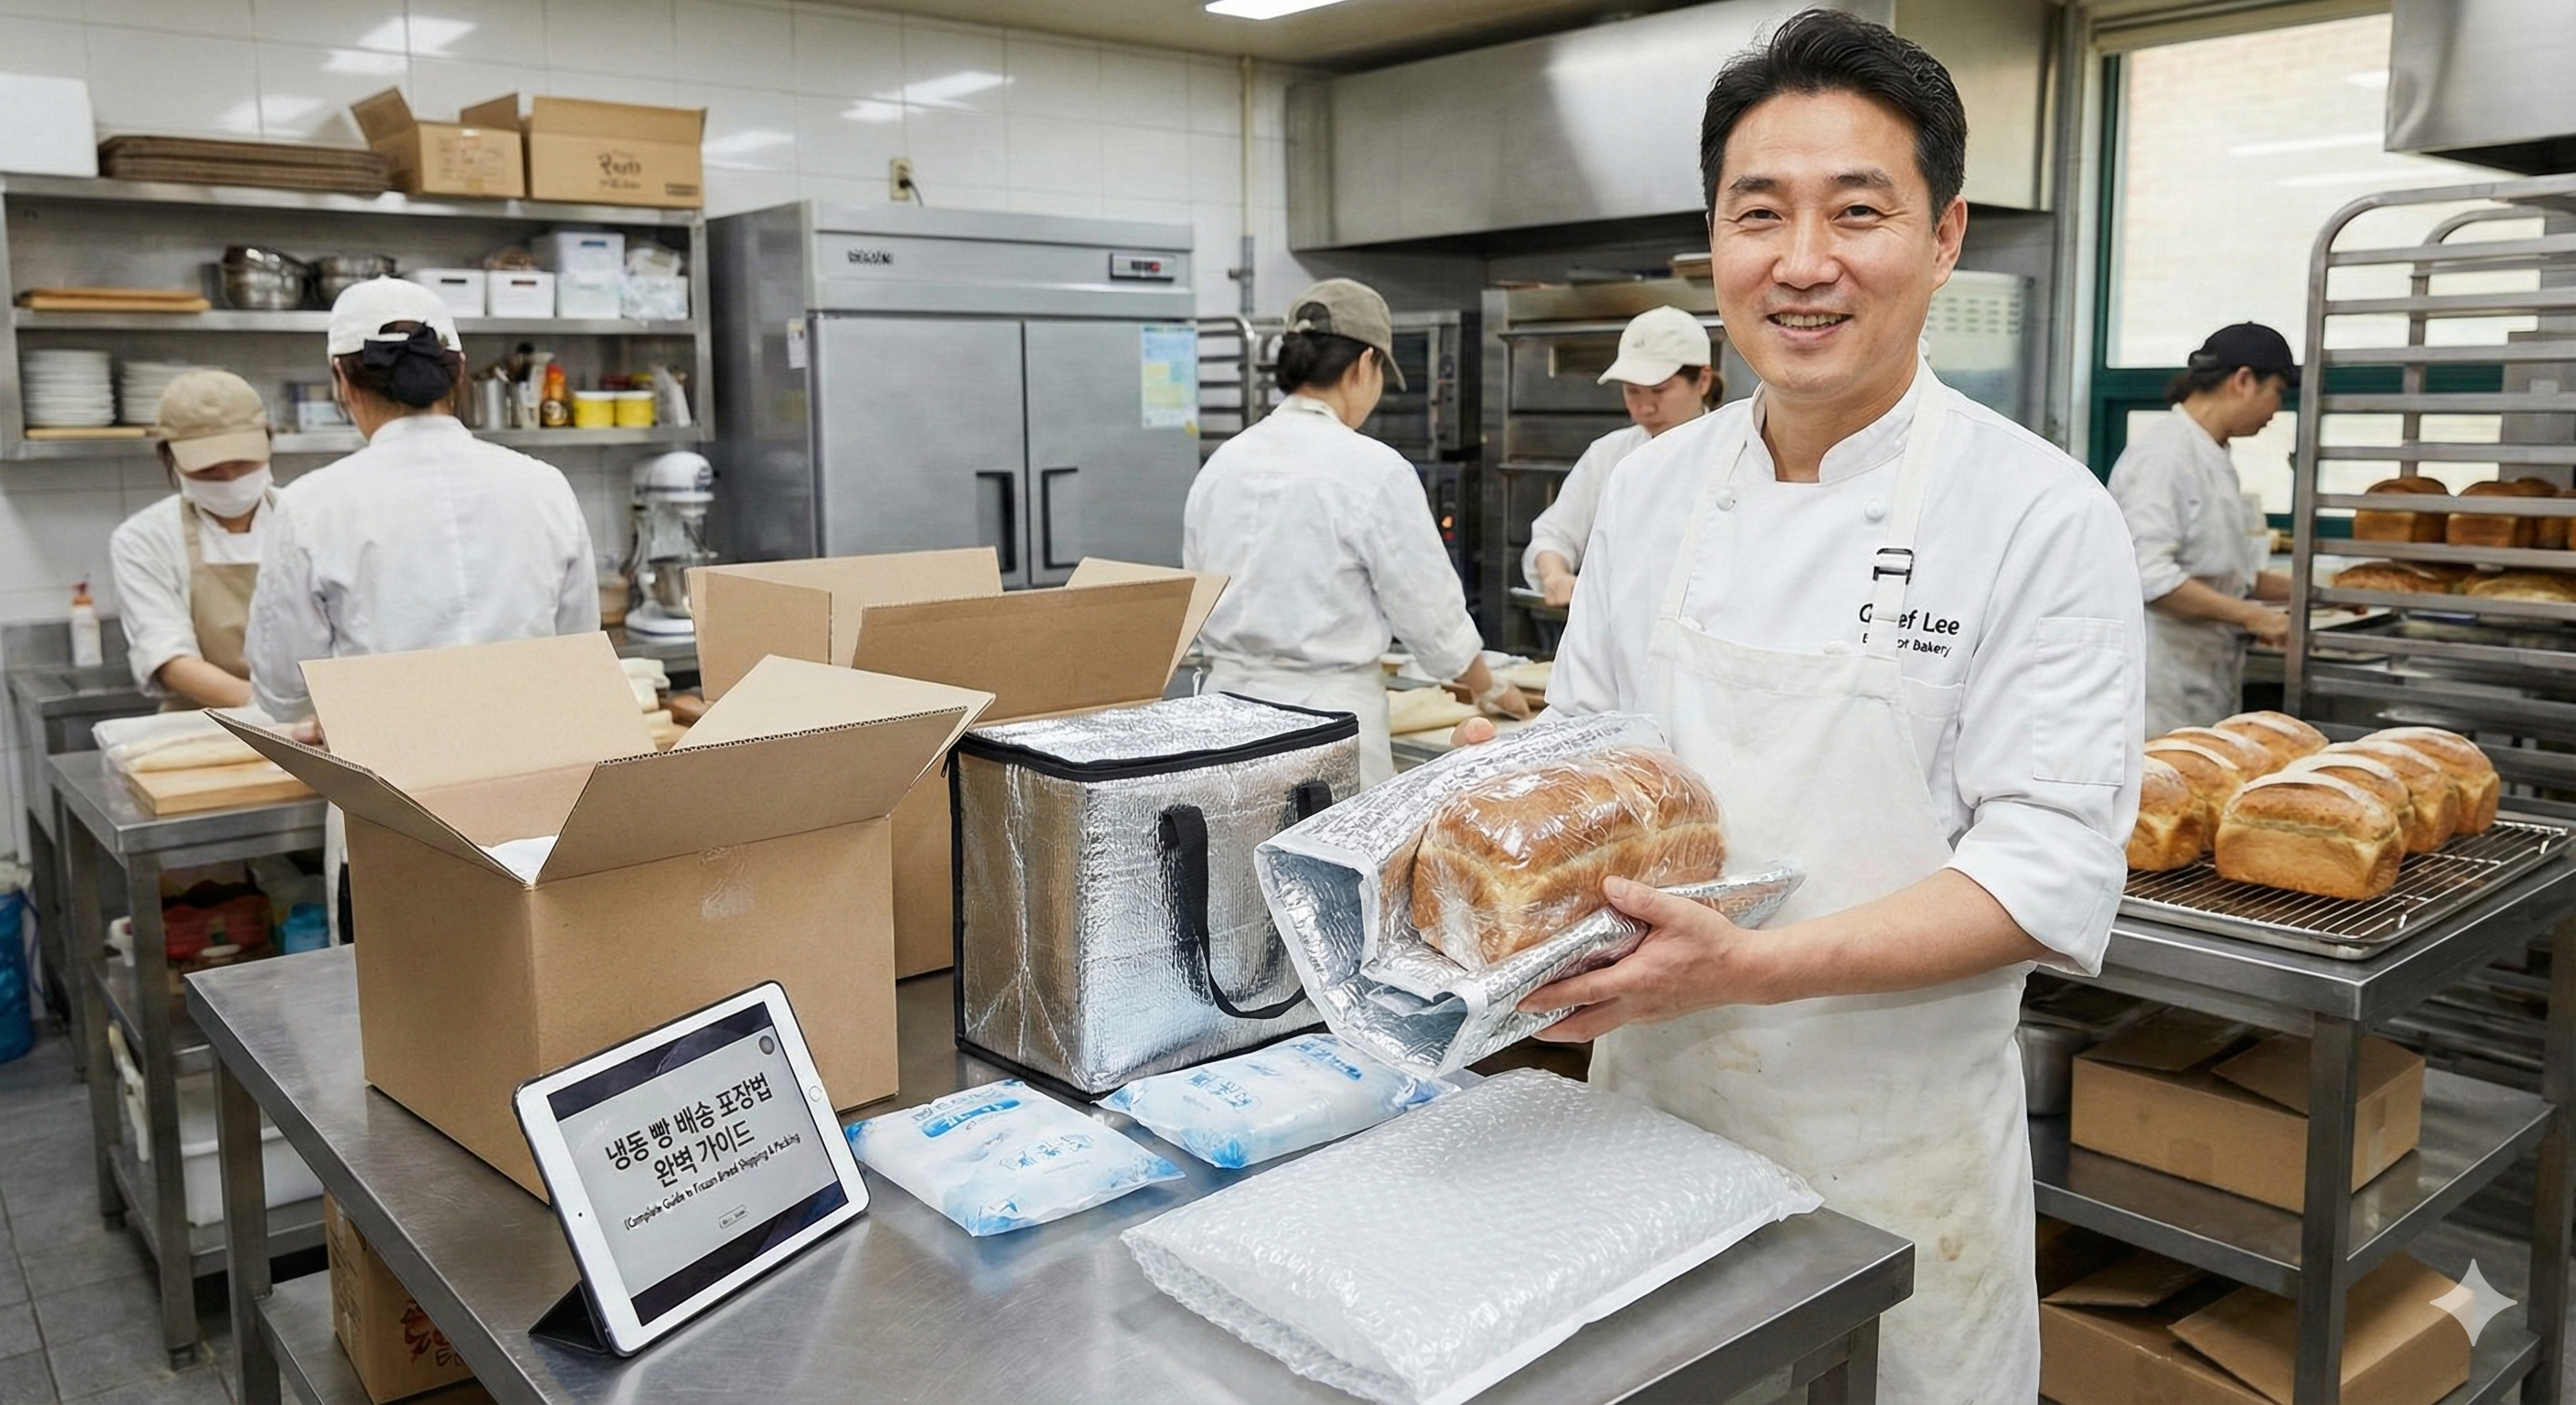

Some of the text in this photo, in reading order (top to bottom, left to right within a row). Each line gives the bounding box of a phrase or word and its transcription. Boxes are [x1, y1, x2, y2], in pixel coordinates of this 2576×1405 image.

[1923, 612, 1959, 635] Lee
[605, 1071, 773, 1170] 냉동 빵 배송 포장법
[653, 1120, 756, 1187] 완벽 가이드
